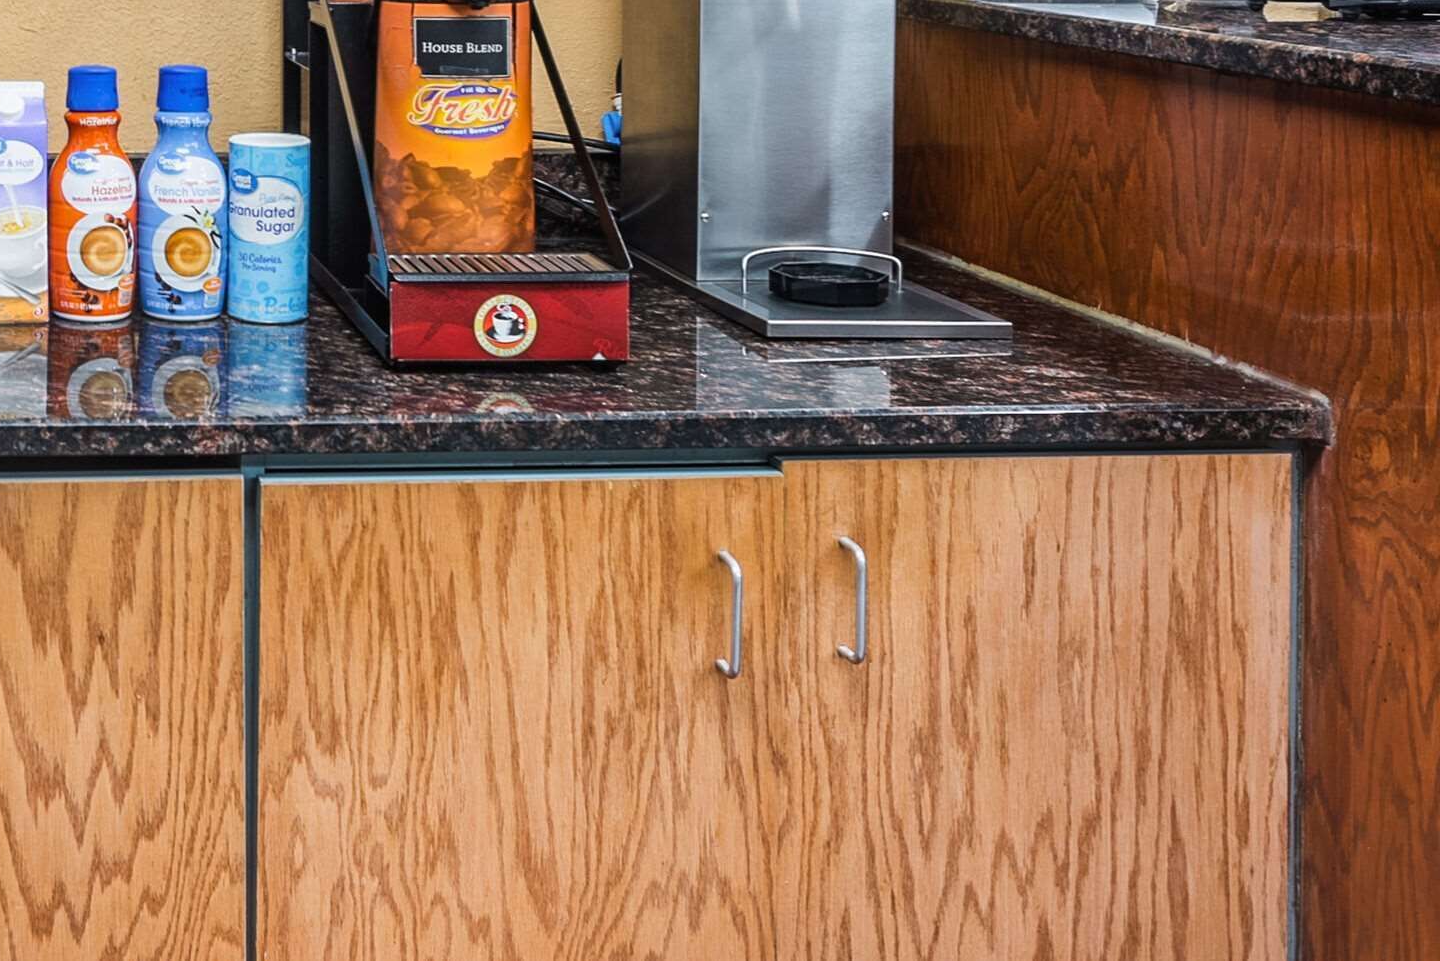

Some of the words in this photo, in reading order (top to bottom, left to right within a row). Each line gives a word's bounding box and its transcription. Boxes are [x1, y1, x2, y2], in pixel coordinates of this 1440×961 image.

[421, 41, 463, 54] HOUSE
[466, 41, 503, 54] BLEND
[407, 83, 517, 126] Fresh
[8, 159, 14, 168] &
[16, 158, 35, 168] Half
[228, 202, 295, 218] Granulated
[256, 220, 295, 235] Sugar
